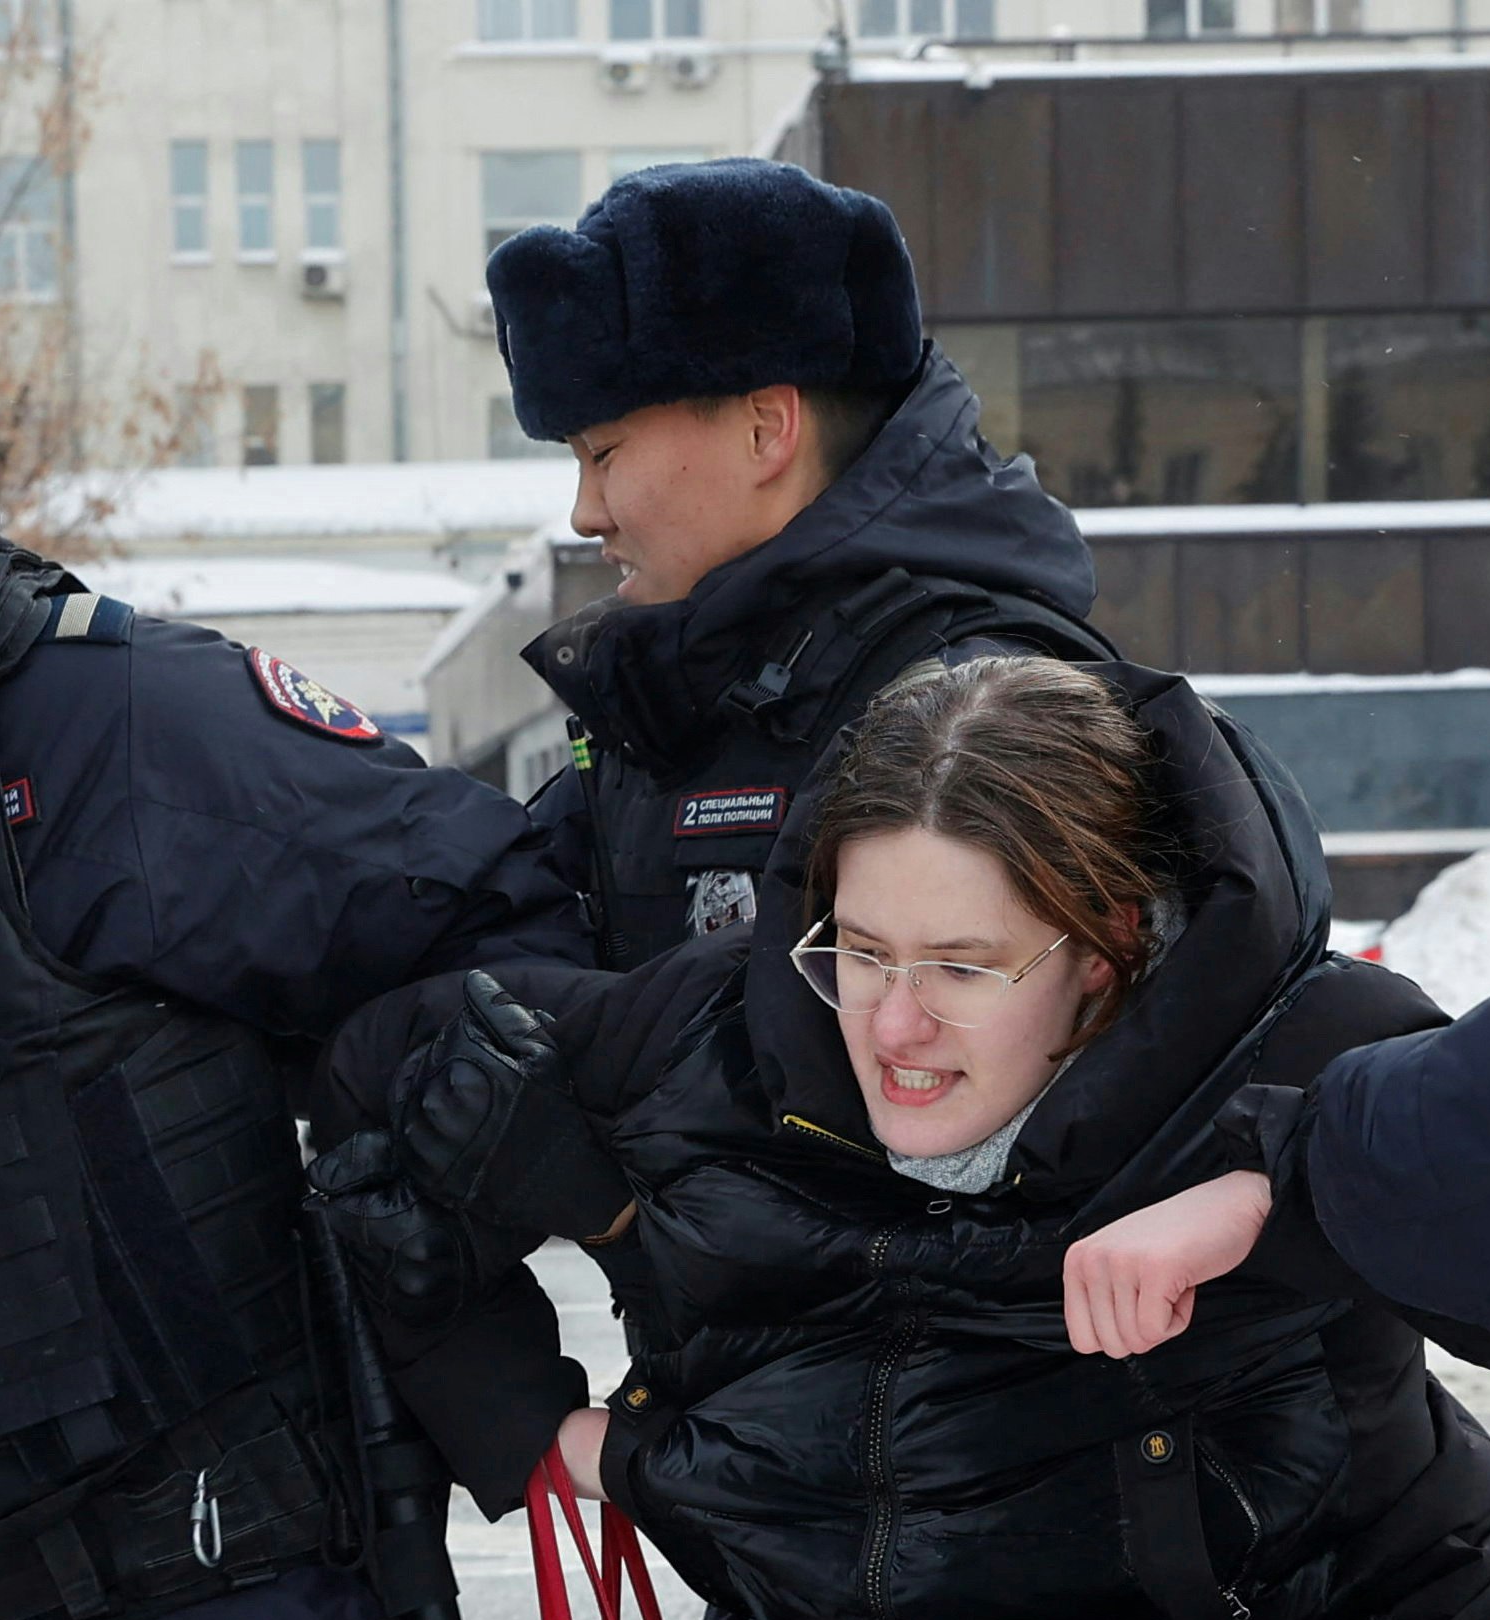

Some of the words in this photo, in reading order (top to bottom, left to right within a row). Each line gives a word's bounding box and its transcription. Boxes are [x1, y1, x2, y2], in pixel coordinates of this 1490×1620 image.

[699, 793, 775, 811] СПЕЦИАЛЬНЫЙ
[683, 801, 698, 826] 2
[697, 812, 723, 825] ПОЛК
[723, 809, 773, 823] ПОЛИЦИИ
